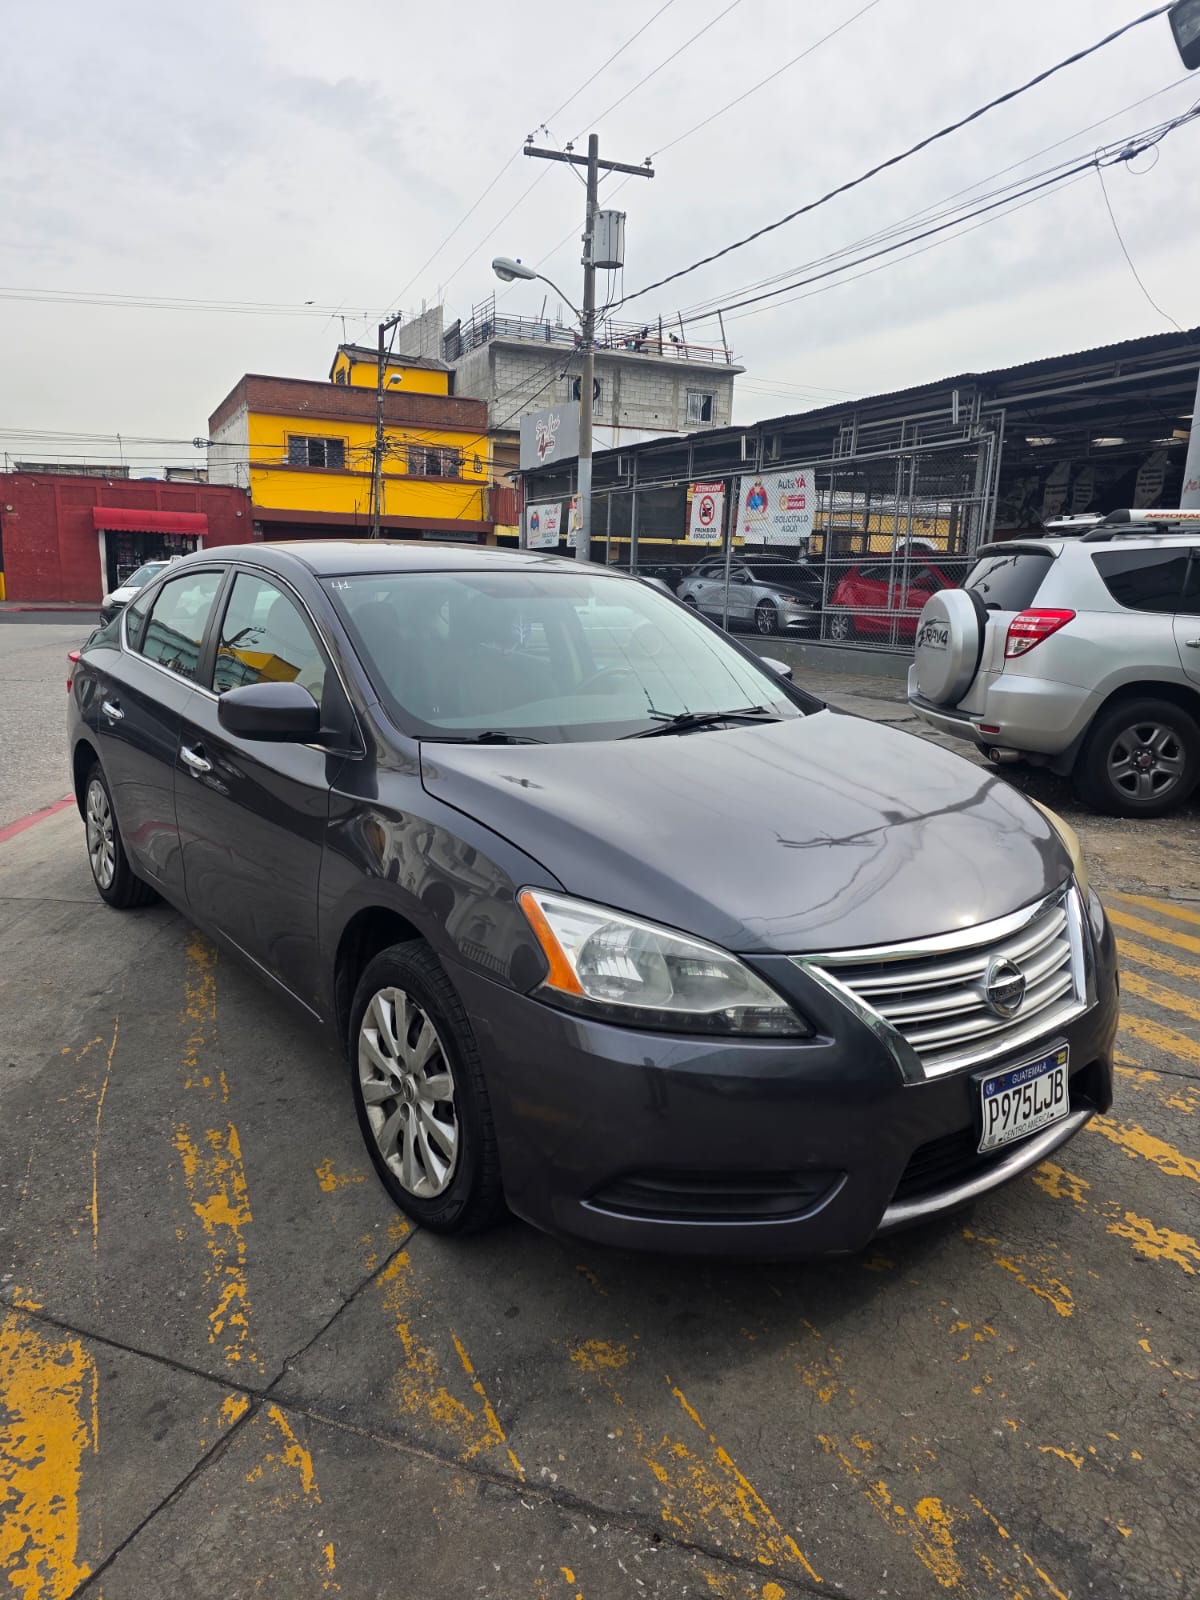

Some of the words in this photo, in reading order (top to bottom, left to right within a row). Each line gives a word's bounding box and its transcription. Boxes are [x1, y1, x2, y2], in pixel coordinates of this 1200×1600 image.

[926, 628, 949, 645] RAV4
[1012, 1062, 1047, 1084] GUATEMALA
[988, 1068, 1064, 1135] P975LJB
